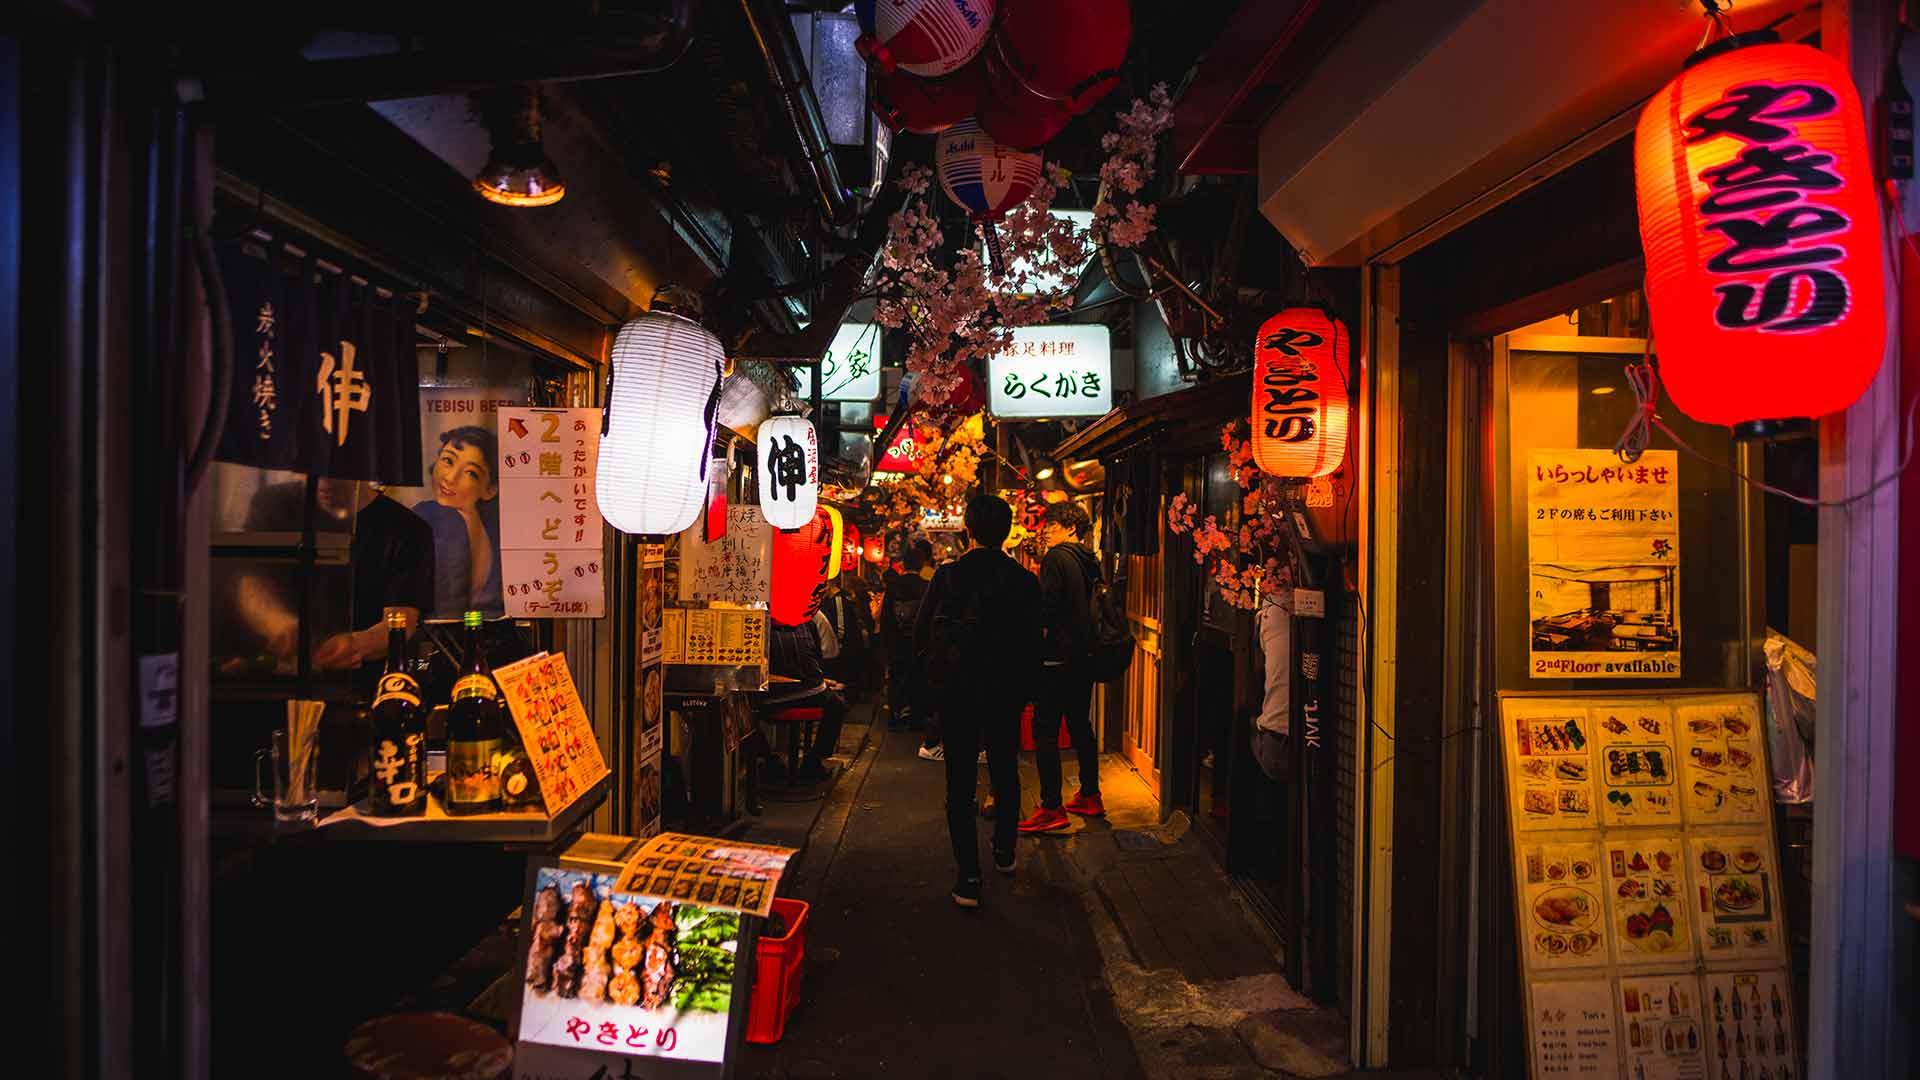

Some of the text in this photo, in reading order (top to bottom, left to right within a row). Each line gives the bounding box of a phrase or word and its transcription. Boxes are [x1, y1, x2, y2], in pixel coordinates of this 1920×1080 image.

[1685, 83, 1851, 331] やきとり
[1003, 371, 1102, 400] らくがき
[1263, 328, 1325, 442] やきとり
[426, 399, 474, 413] YEBISU
[768, 434, 807, 502] 伸
[1536, 464, 1670, 484] いらっしゃいませ
[538, 413, 564, 603] 2階へどうぞ
[1536, 508, 1673, 521] 2Fの席もご利用下さい
[1535, 659, 1675, 673] 2ndFloor available
[374, 739, 420, 806] 辛口
[565, 1016, 678, 1052] やきとり
